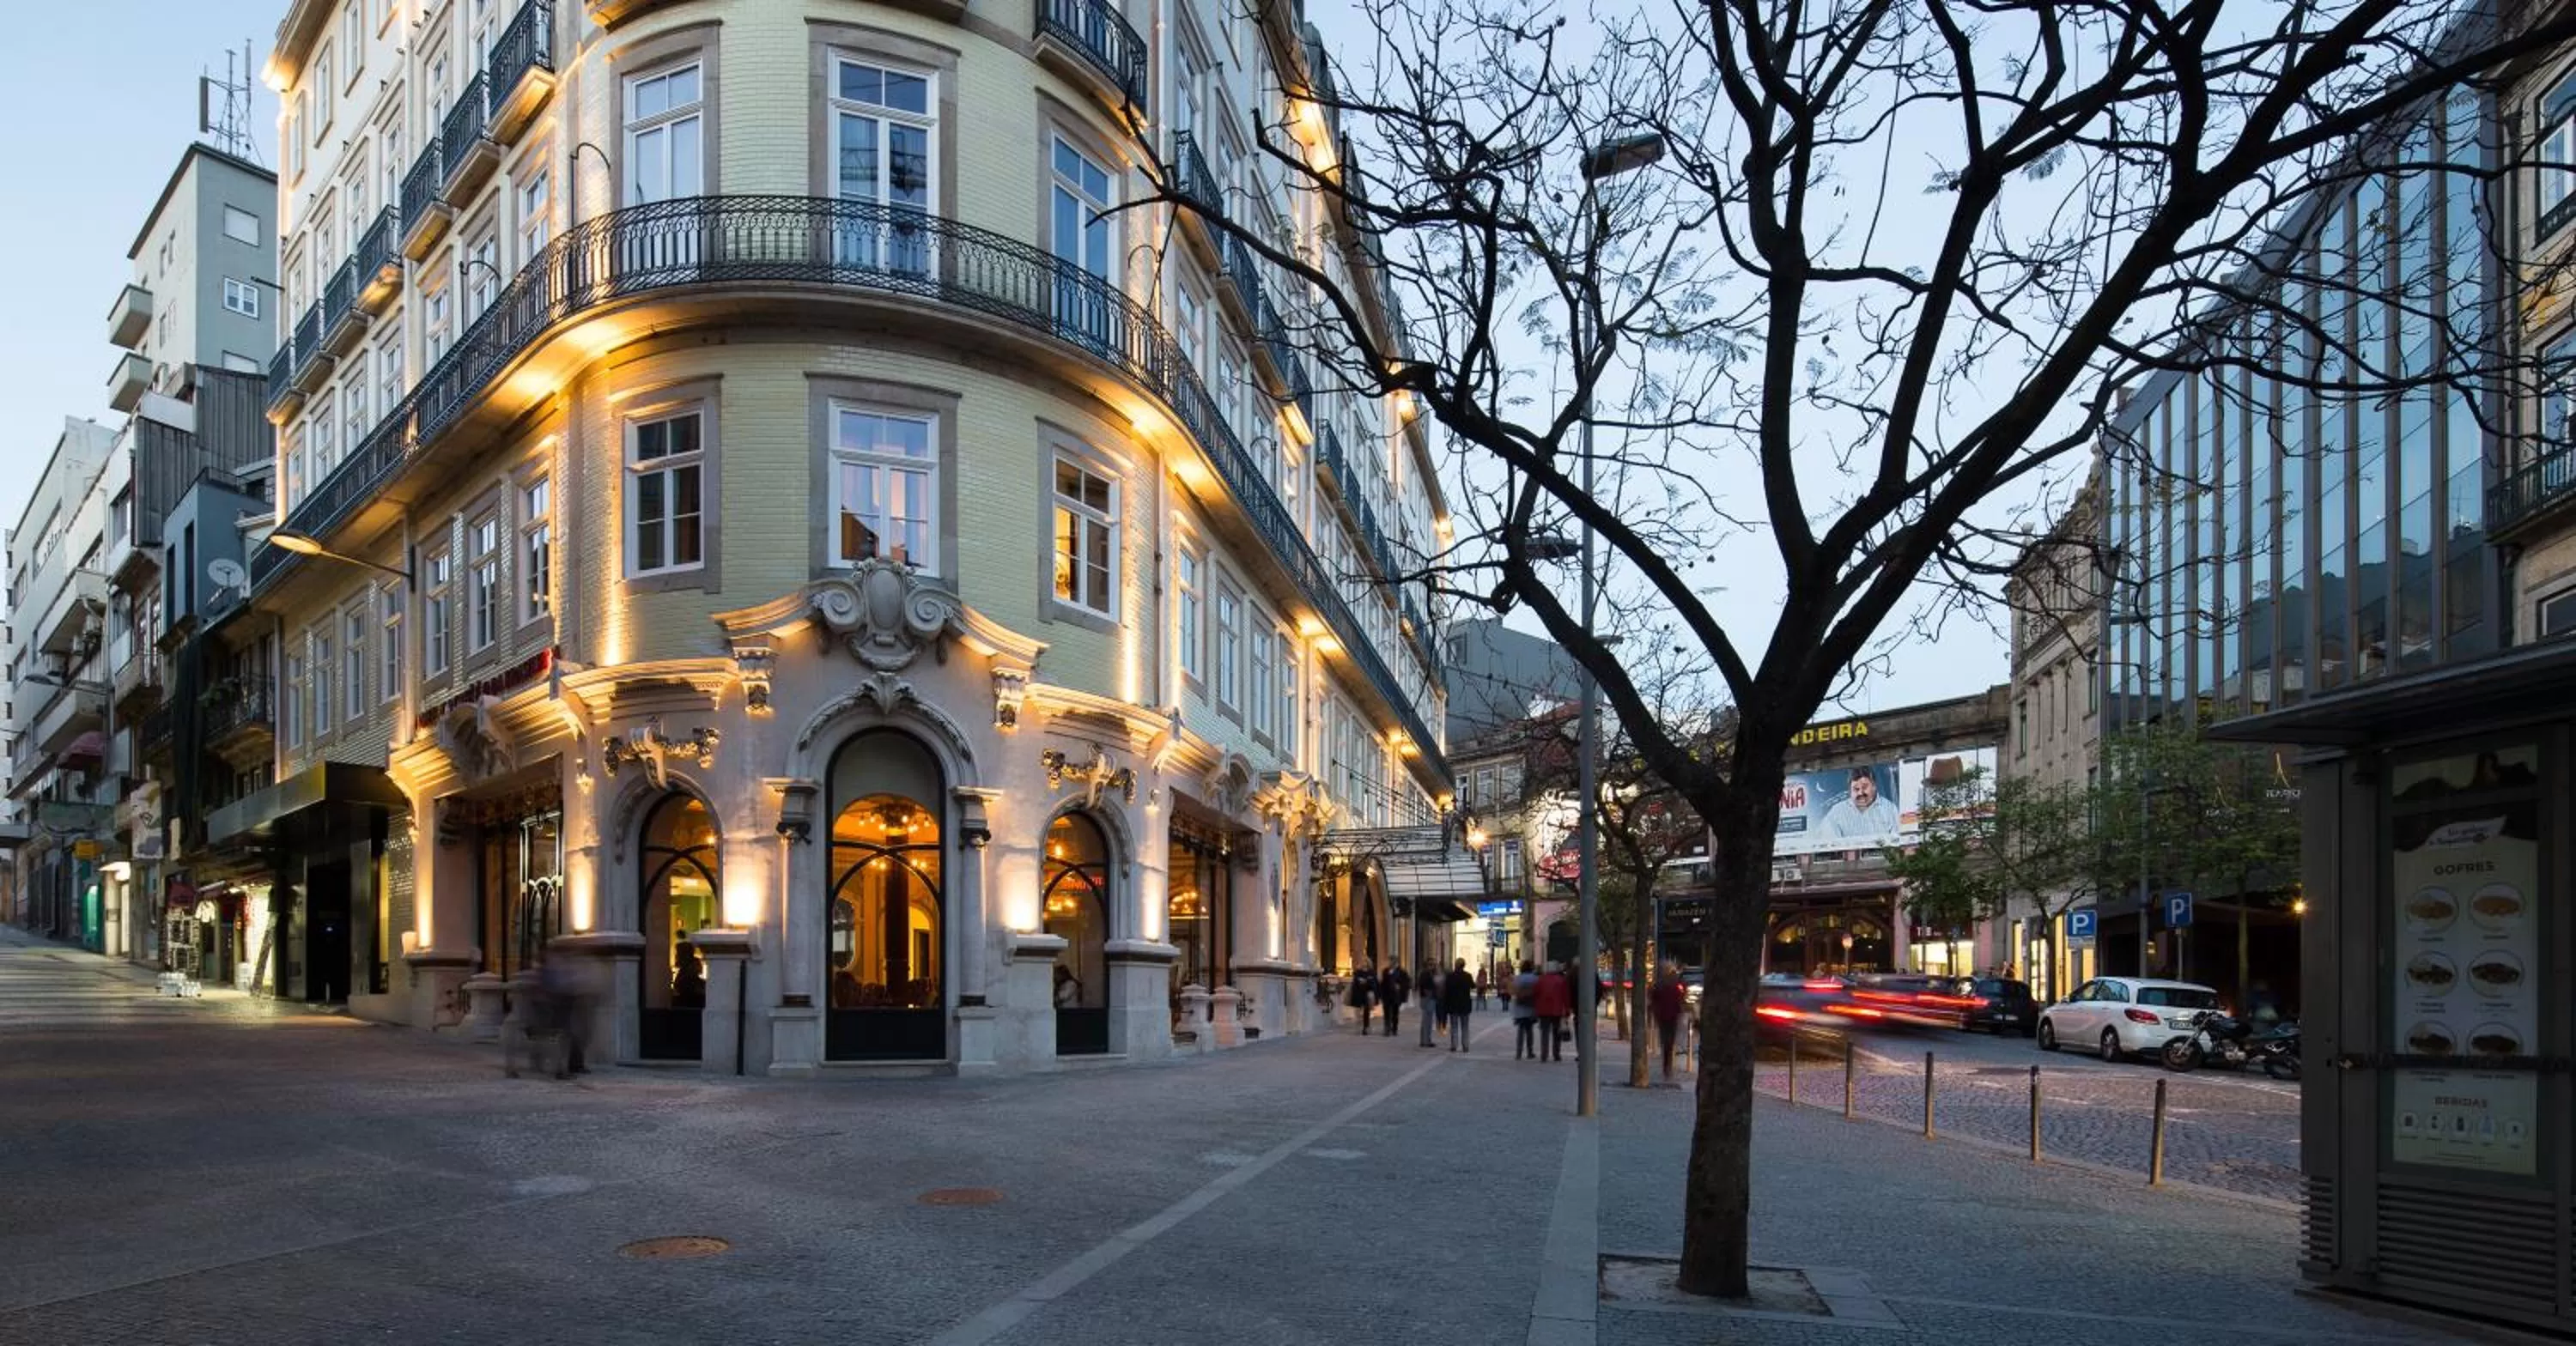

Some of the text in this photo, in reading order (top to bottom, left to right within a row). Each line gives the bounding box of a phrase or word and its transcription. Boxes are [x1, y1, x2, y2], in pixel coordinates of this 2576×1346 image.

[1789, 721, 1868, 745] NDEIRA
[2433, 860, 2495, 876] GOFRES
[2172, 899, 2184, 925] P
[2073, 914, 2089, 935] P
